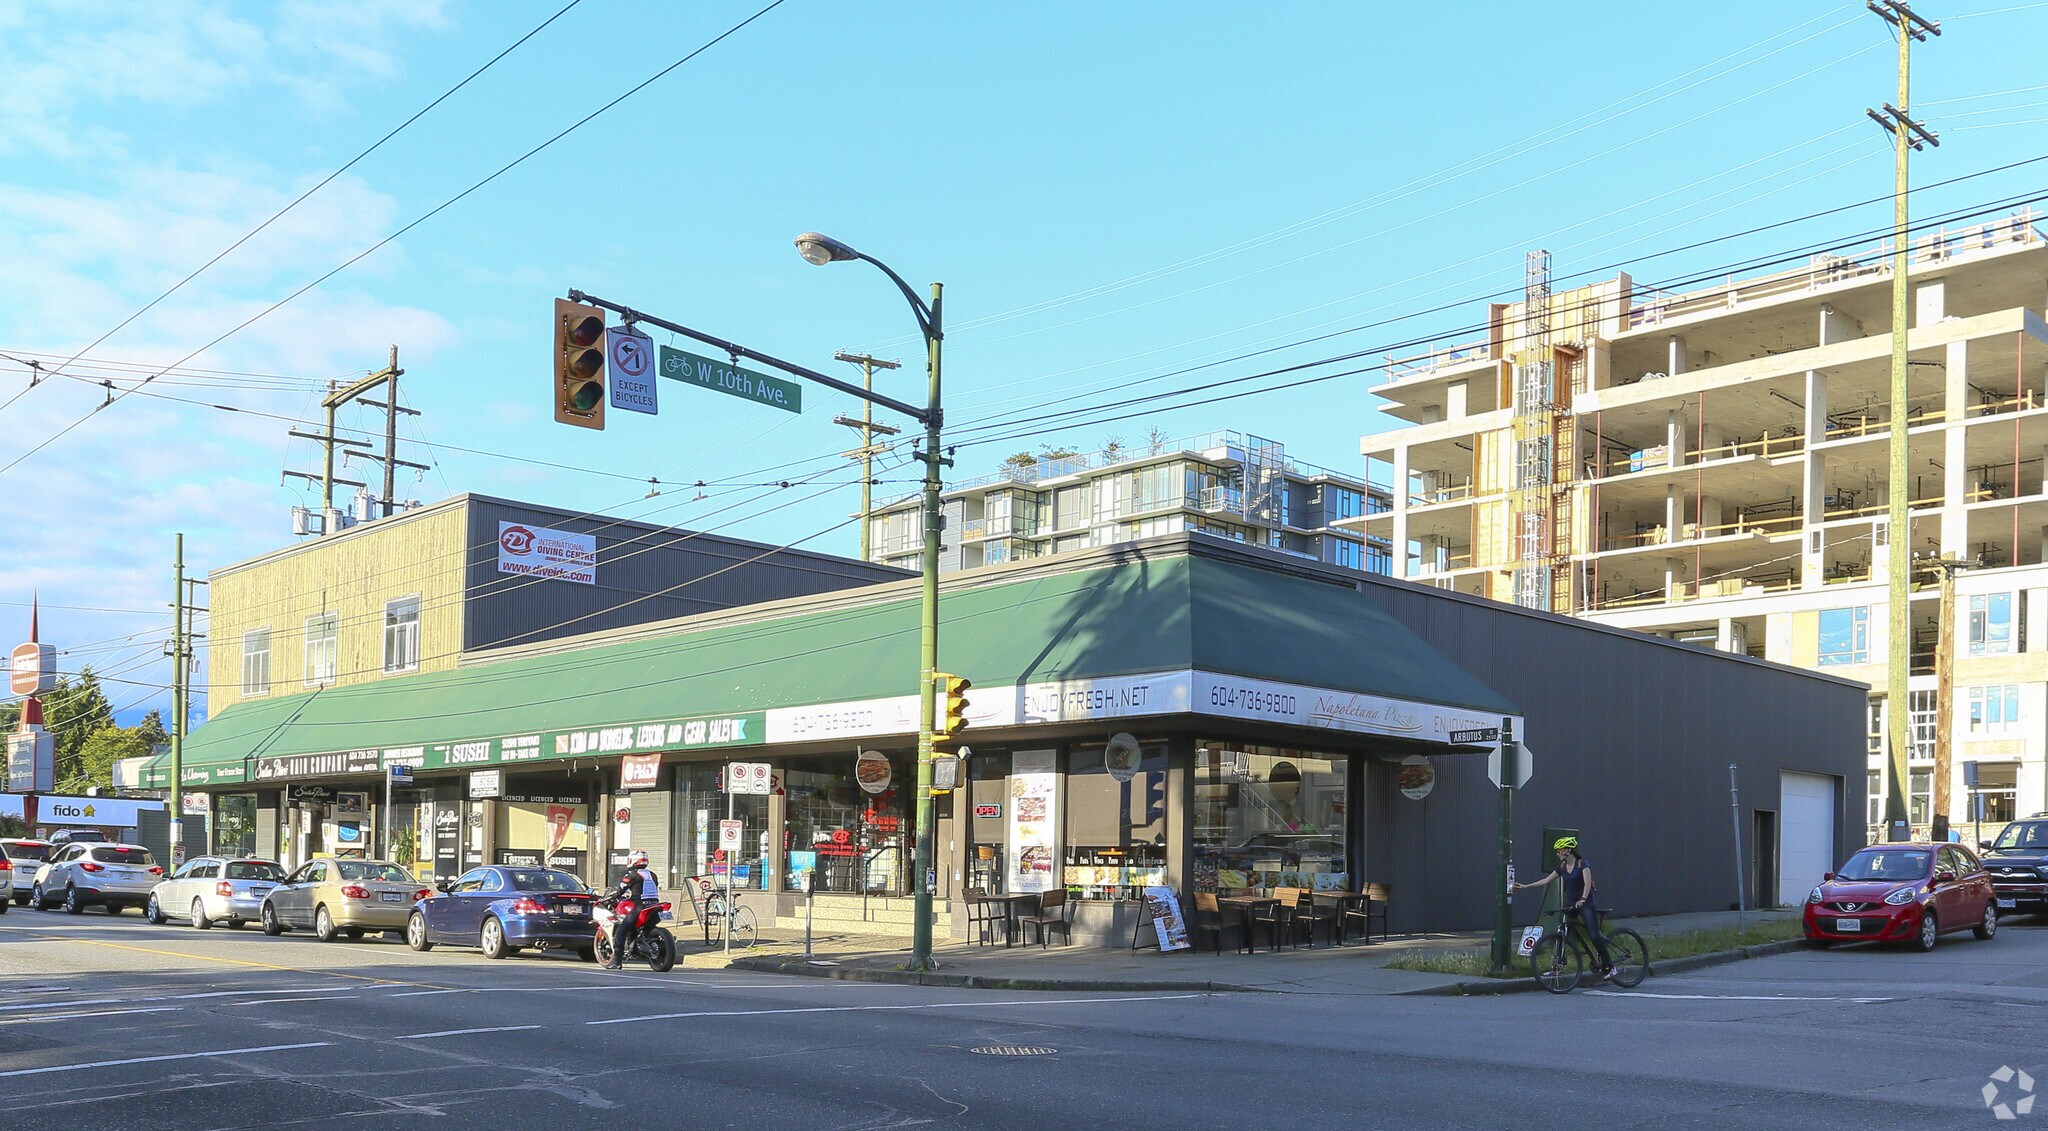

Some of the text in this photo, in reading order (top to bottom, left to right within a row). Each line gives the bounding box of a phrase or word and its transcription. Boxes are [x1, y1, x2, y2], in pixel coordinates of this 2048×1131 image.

[618, 380, 648, 393] EXCEPT
[697, 361, 788, 405] W 10th Ave.
[615, 391, 653, 407] BICYCLES
[538, 538, 585, 551] INTERNATIONAL
[537, 546, 563, 557] DIVING
[565, 549, 595, 561] CENTRE
[502, 562, 592, 582] www.diveidc.com
[1023, 685, 1149, 714] ENJOYFRESH.NET
[1211, 685, 1296, 715] 604-736-9800
[1314, 694, 1414, 727] Napoletana Pizza
[684, 720, 706, 745] GEAR
[708, 718, 731, 744] SALES
[1453, 731, 1482, 742] ARBUTUS
[452, 742, 491, 763] SUSHI
[255, 759, 272, 779] Salon
[310, 754, 347, 774] COMPANY
[558, 796, 582, 804] LICENCED
[53, 804, 81, 817] fido
[976, 806, 999, 816] OPEN
[549, 857, 577, 866] SUSHI
